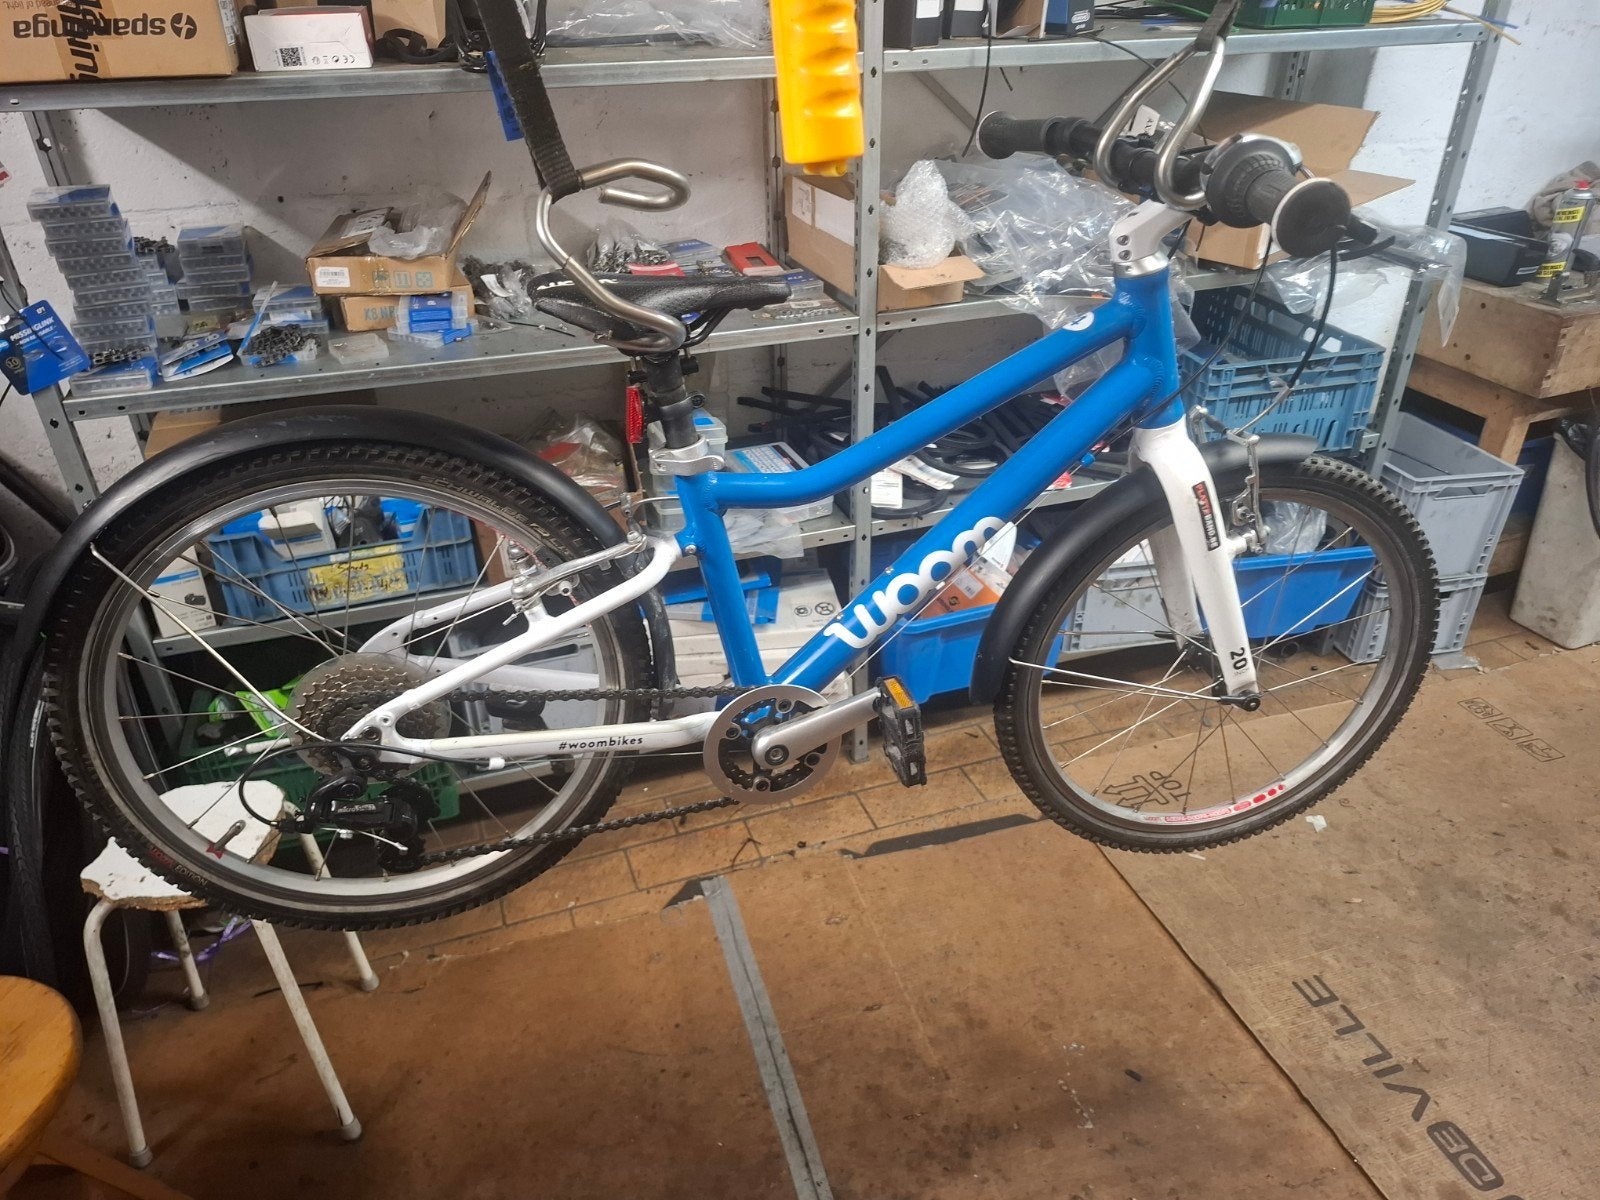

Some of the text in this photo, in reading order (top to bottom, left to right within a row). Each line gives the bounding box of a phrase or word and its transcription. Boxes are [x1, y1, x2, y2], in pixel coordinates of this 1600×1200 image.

[823, 516, 1007, 648] woom
[1229, 647, 1248, 670] 20
[558, 736, 643, 751] #woombikes
[1292, 974, 1431, 1122] VILLE
